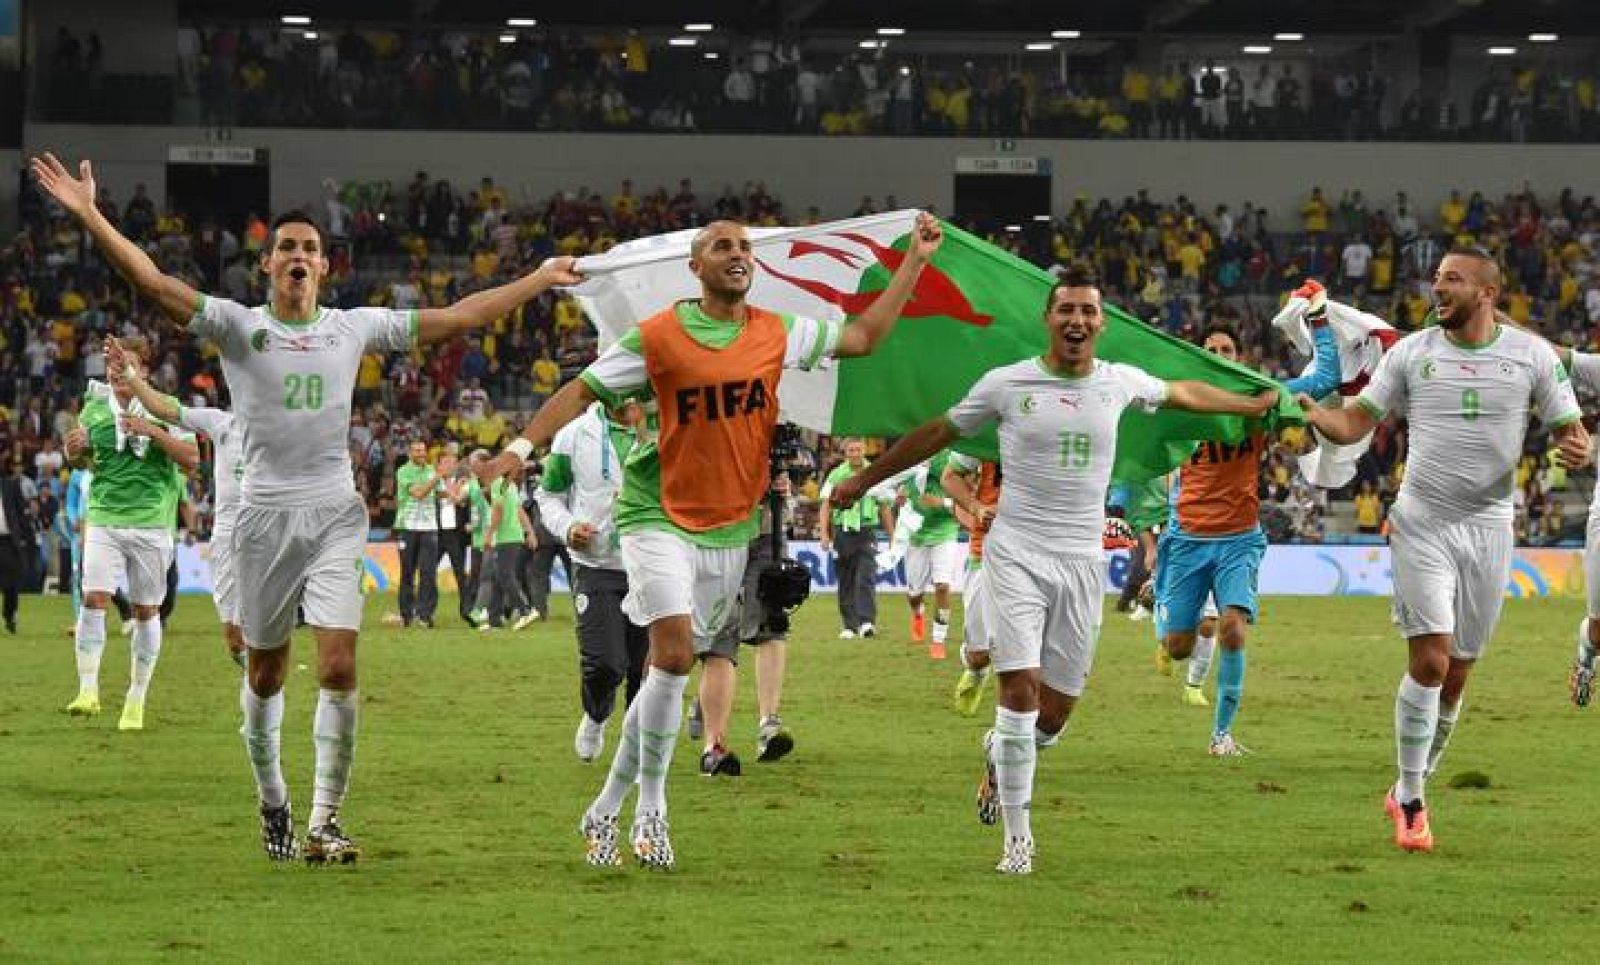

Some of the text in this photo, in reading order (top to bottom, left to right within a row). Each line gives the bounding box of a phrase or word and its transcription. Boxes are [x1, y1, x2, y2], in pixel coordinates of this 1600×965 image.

[283, 373, 322, 410] 20
[677, 378, 766, 426] FIFA
[1057, 430, 1090, 469] 19
